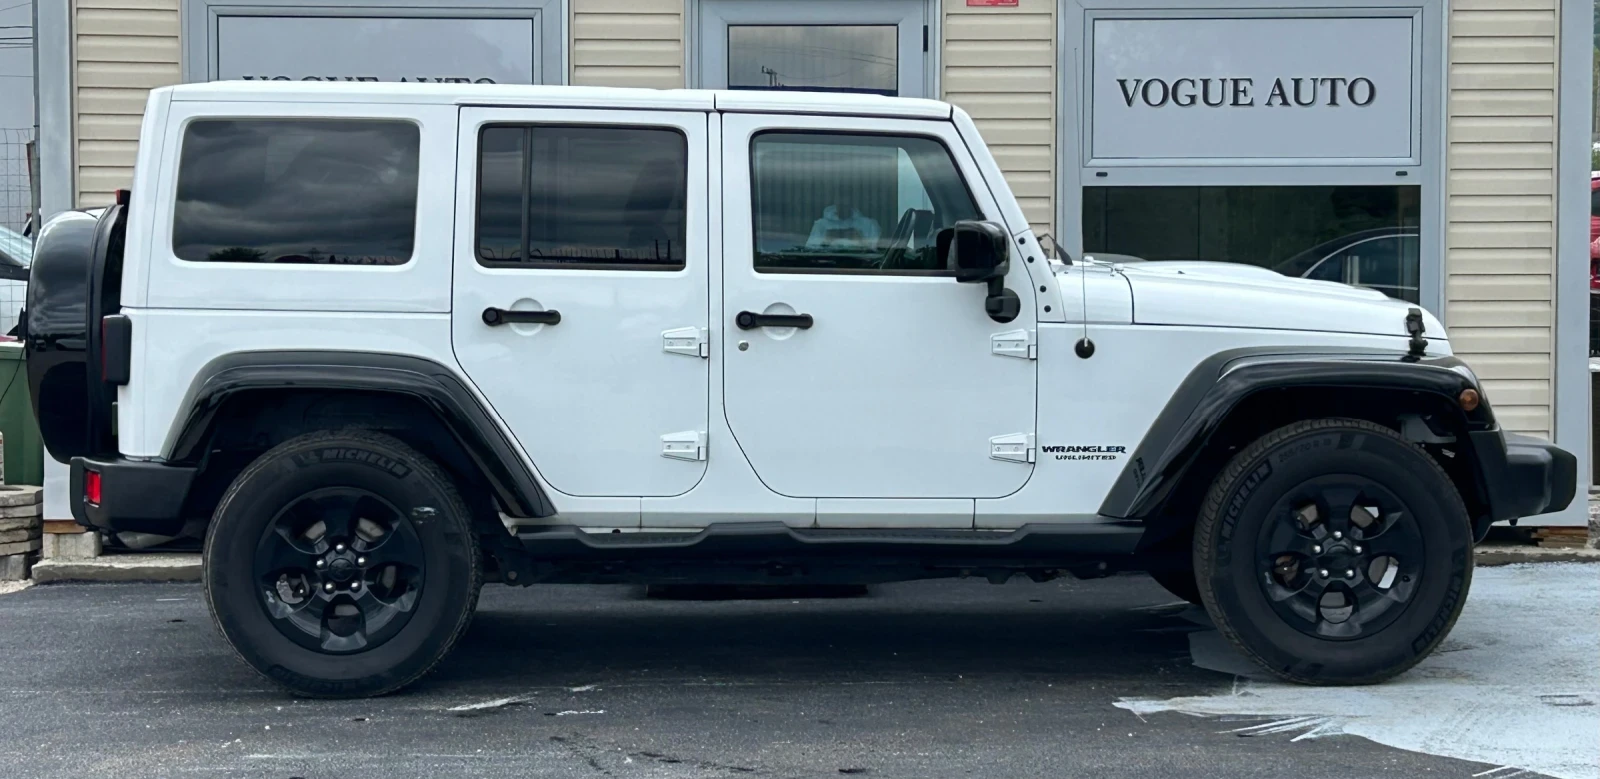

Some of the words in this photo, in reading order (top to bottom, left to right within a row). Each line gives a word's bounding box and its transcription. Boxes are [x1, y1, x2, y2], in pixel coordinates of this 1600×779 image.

[1116, 78, 1254, 107] VOGUE
[1265, 77, 1376, 107] AUTO
[322, 448, 409, 476] MICHELIN
[1220, 462, 1270, 539] MICHELIN
